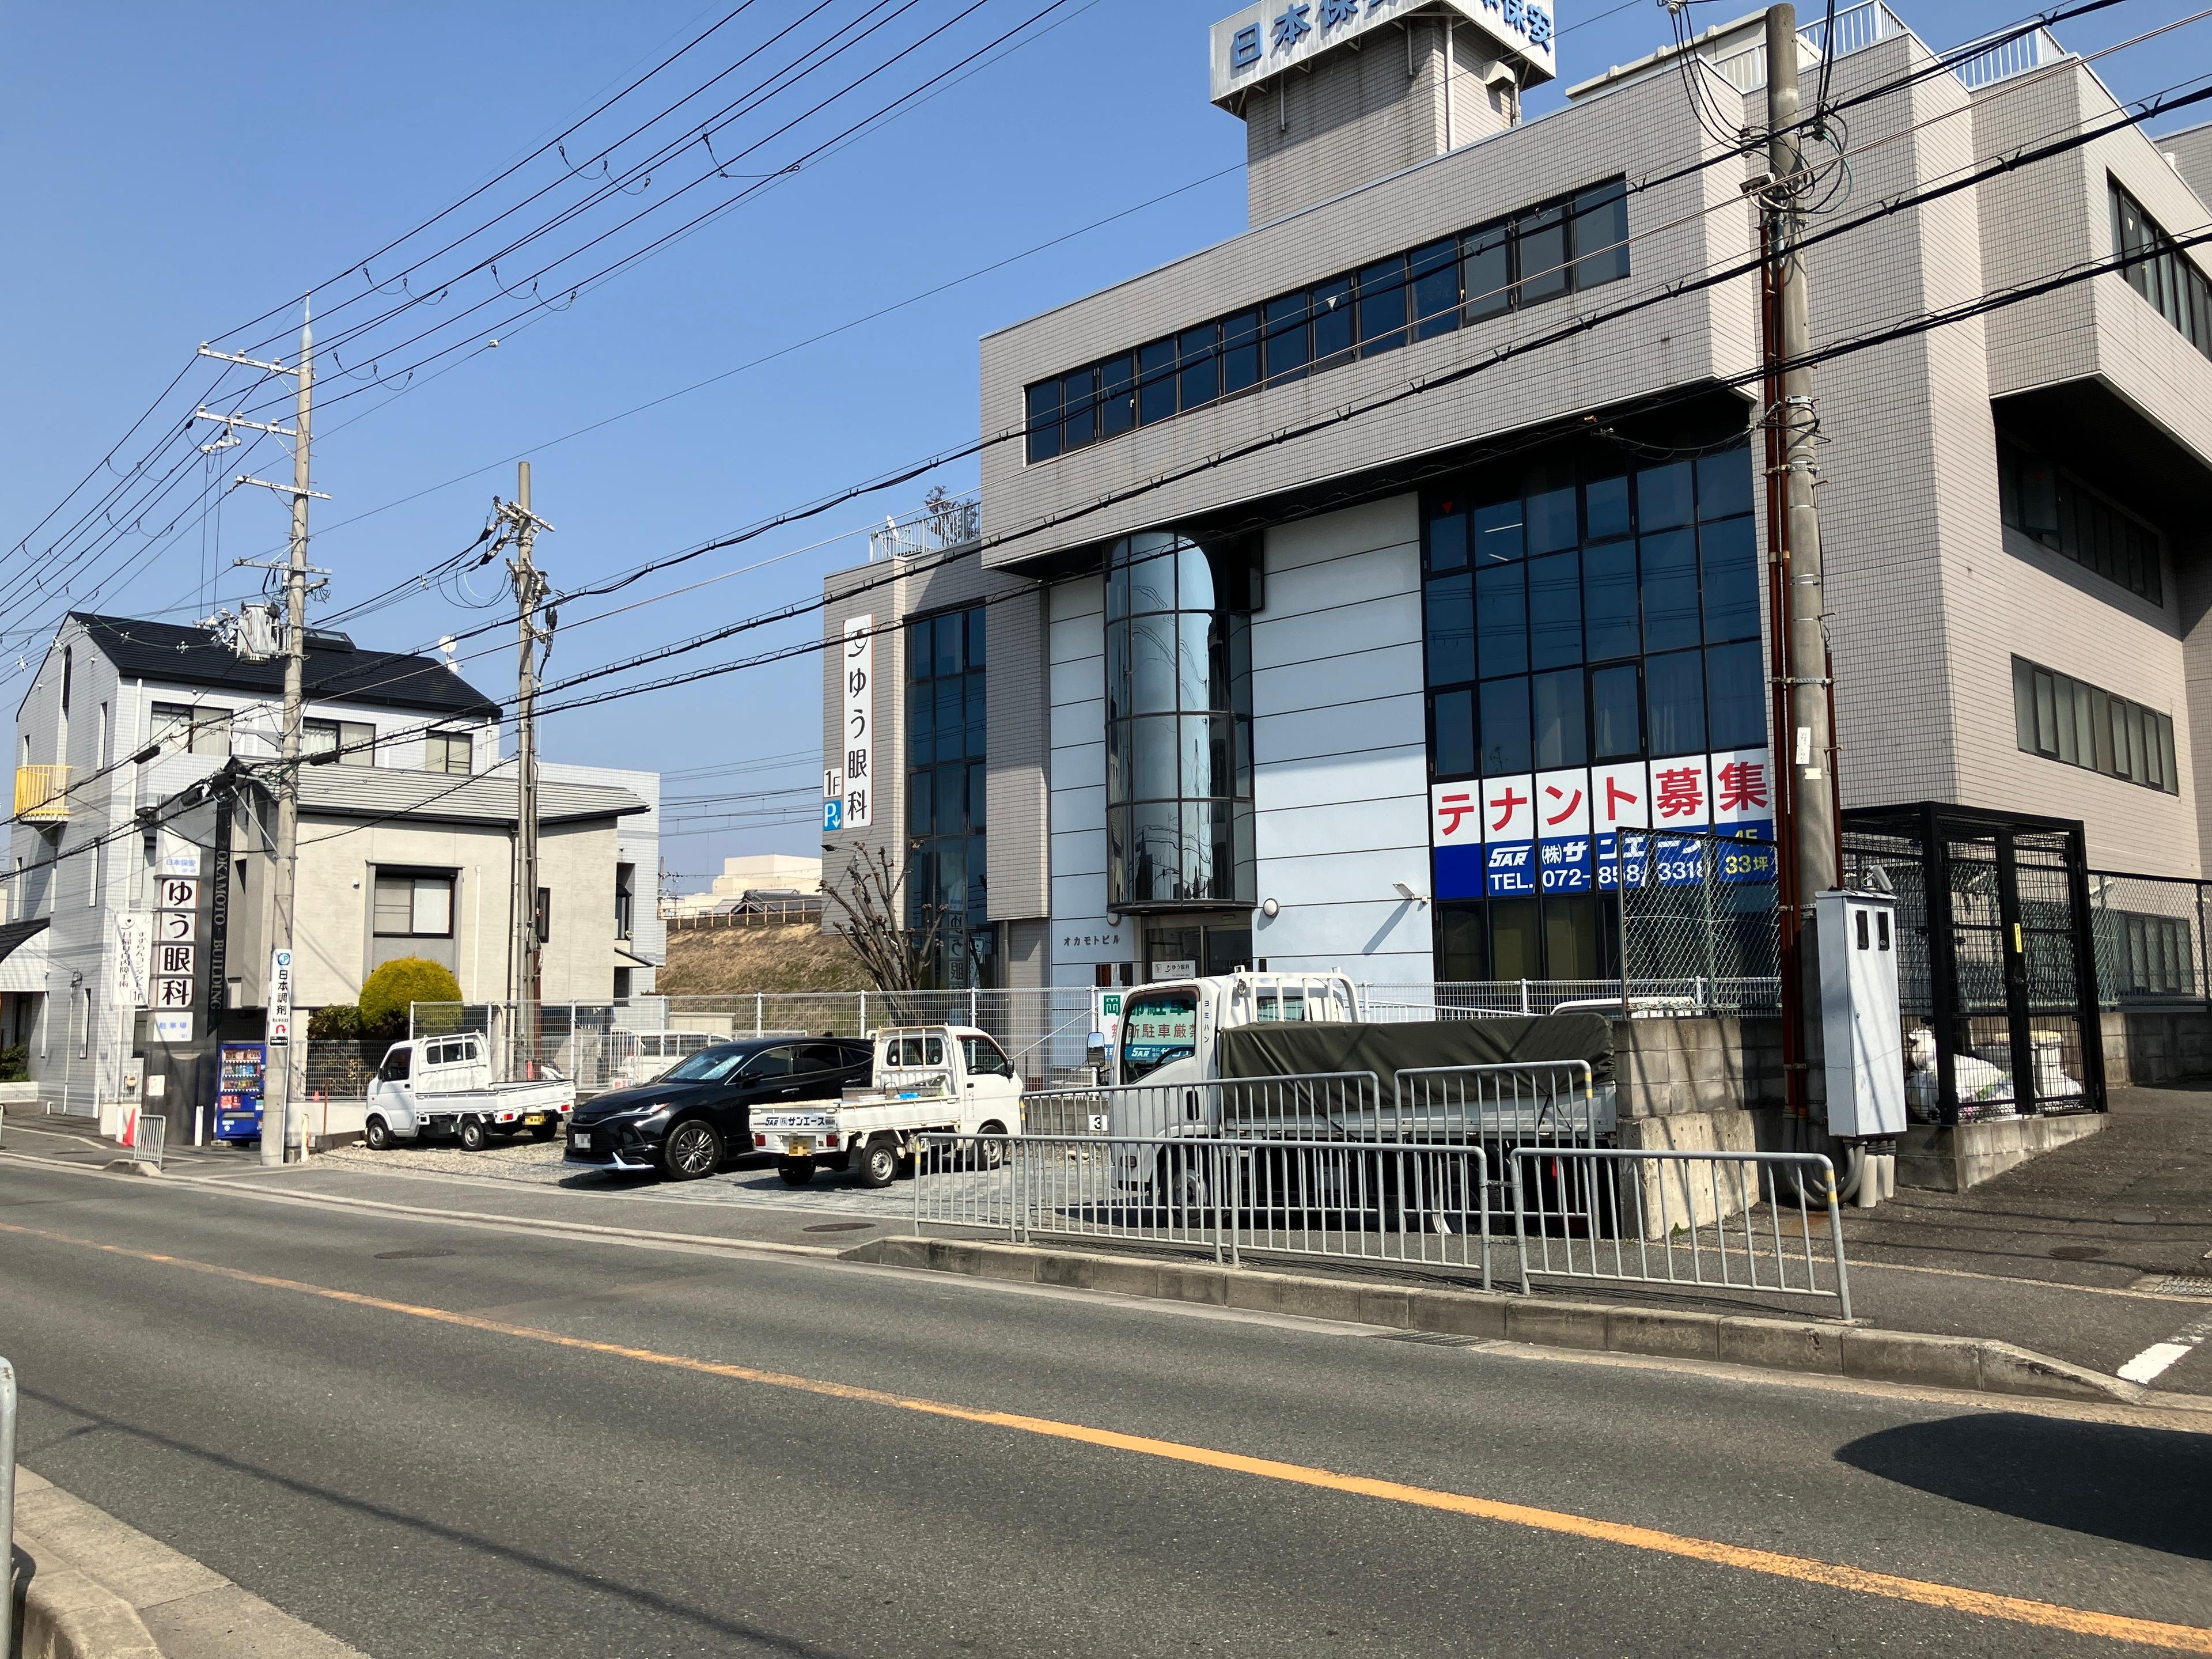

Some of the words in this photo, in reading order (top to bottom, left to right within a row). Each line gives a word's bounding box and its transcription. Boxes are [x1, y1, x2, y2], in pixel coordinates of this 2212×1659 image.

[1233, 0, 1381, 67] 日本保
[1480, 0, 1552, 53] 保安
[847, 668, 868, 821] ゆう眼科
[825, 771, 841, 796] 1F
[1438, 762, 1768, 836] テナント募集
[824, 803, 836, 828] P
[214, 850, 229, 925] OKAMOTO
[1490, 873, 1533, 890] TEL.
[1725, 855, 1768, 874] 33坪
[162, 881, 192, 1005] ゆう眼科
[210, 938, 225, 1009] BUILDING
[276, 969, 288, 1016] 日本調剤
[1094, 1116, 1101, 1130] 3
